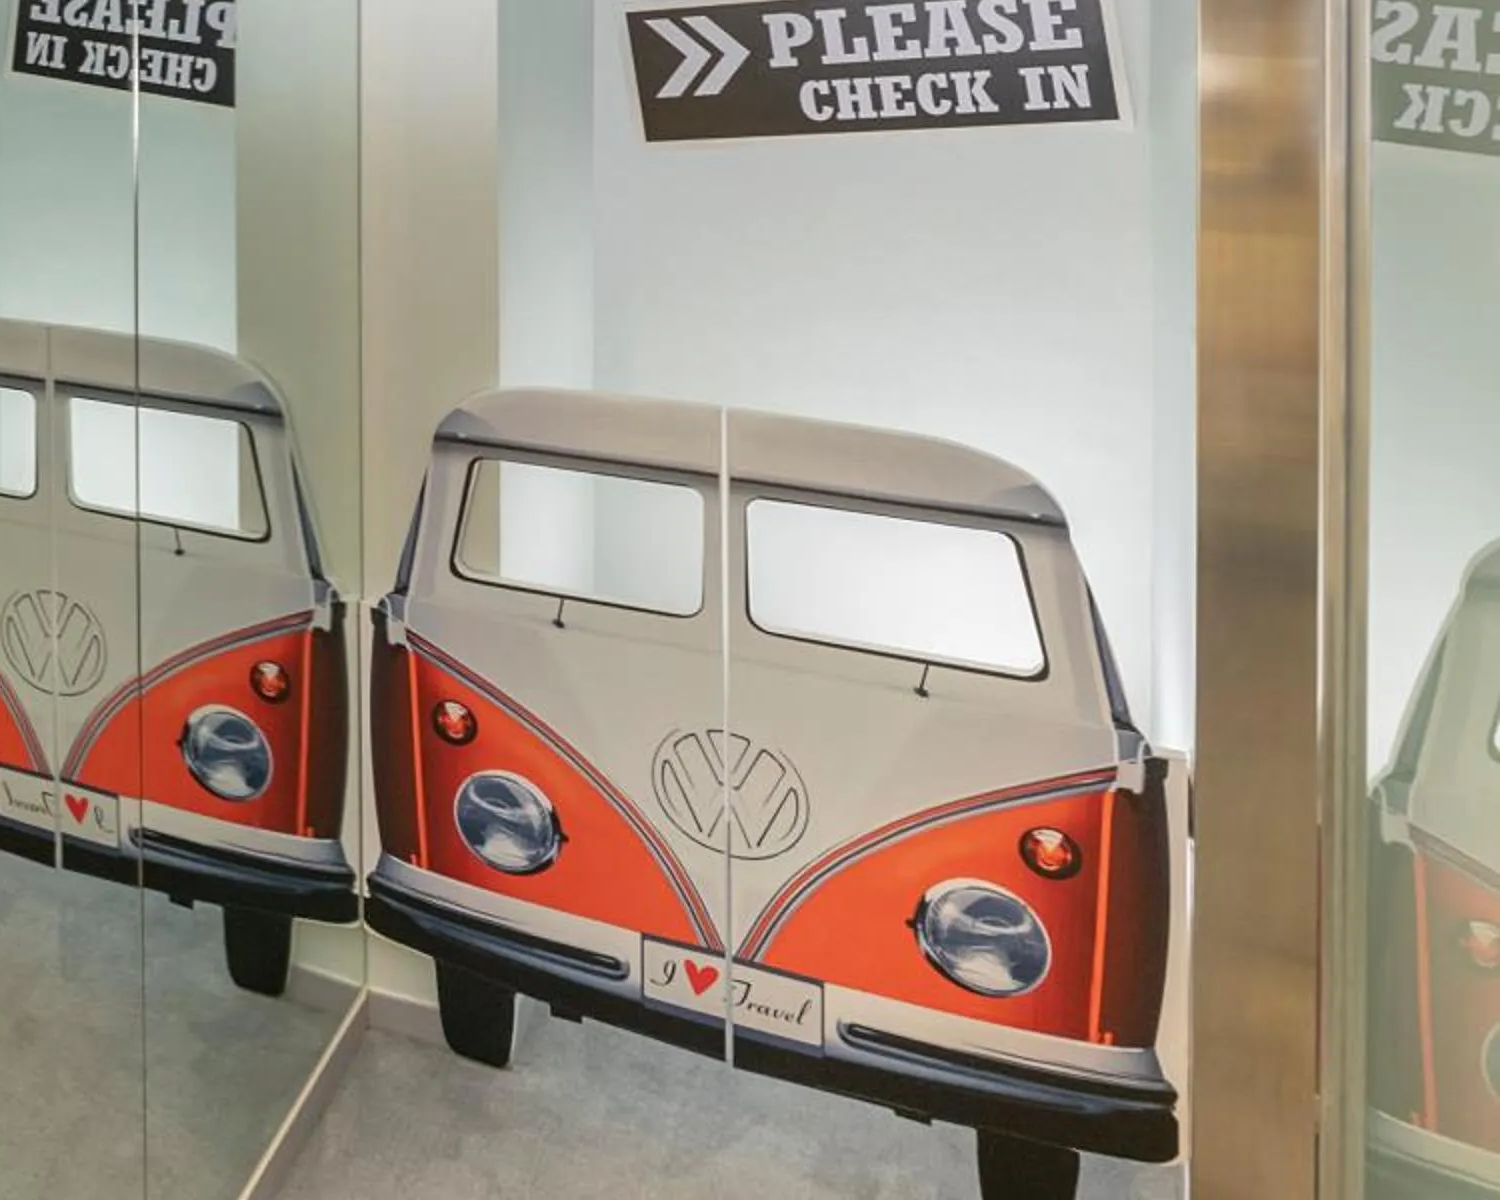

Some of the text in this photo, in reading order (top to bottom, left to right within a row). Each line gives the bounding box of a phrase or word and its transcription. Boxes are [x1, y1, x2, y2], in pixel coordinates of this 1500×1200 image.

[799, 63, 1092, 122] CHECK IN
[722, 978, 812, 1026] Travel
